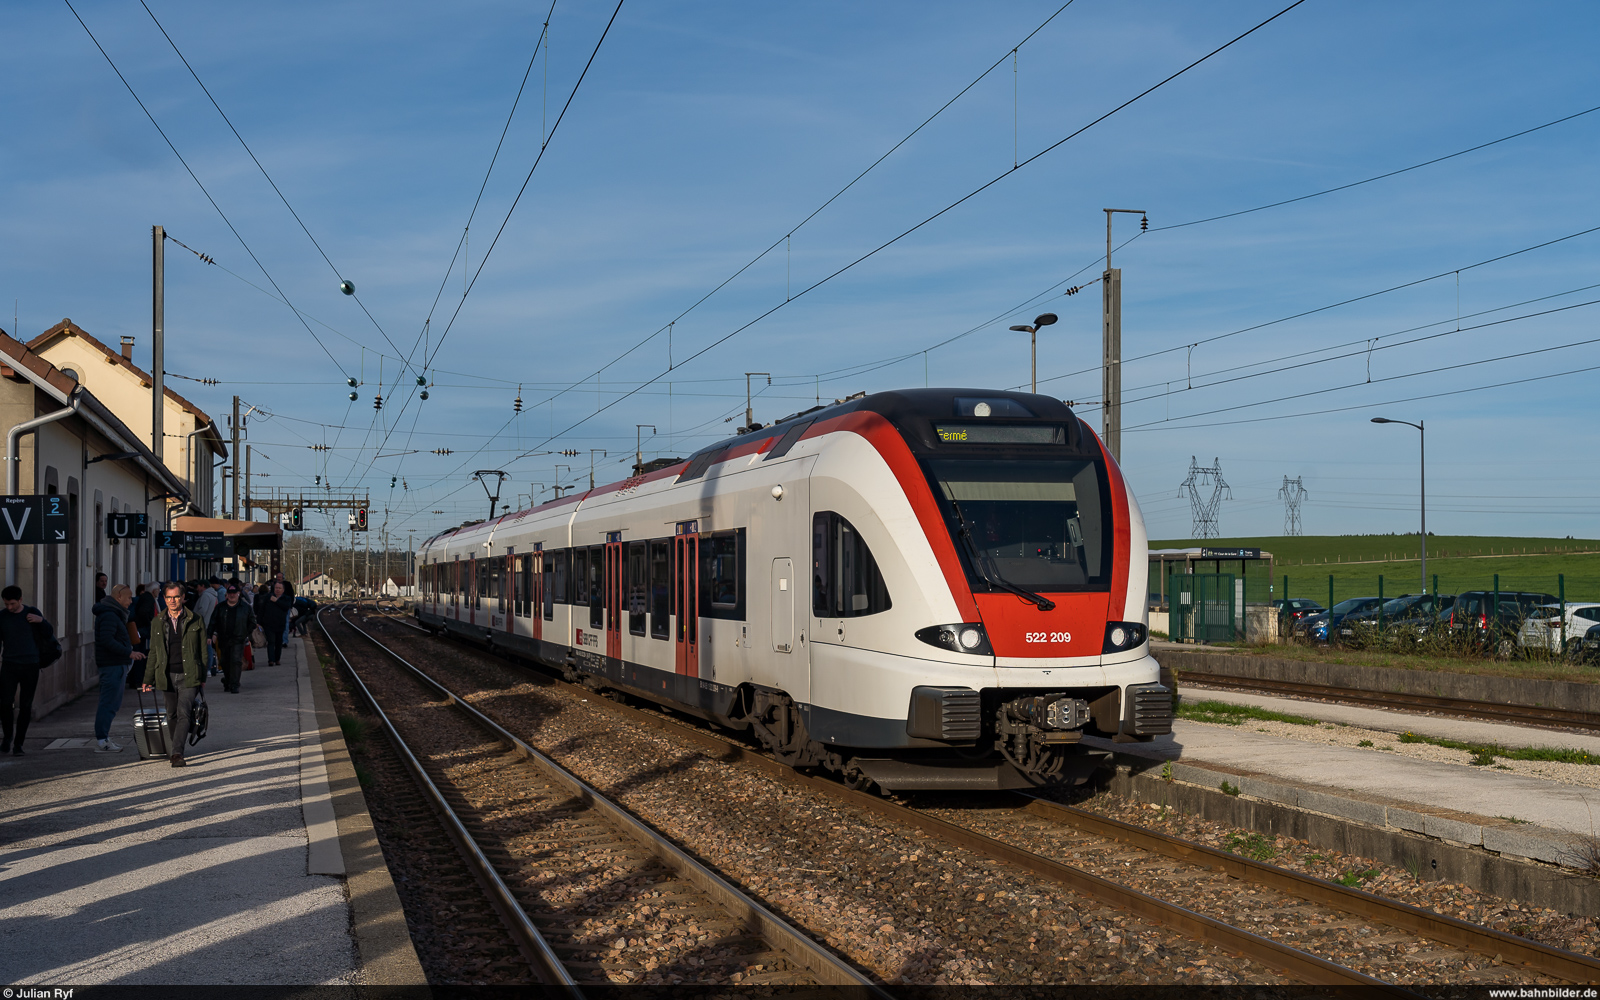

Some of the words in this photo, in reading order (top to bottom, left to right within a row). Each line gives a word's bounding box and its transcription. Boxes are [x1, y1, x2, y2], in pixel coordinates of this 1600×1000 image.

[937, 429, 968, 440] Fermé
[51, 503, 60, 514] 2
[2, 508, 32, 540] V
[114, 519, 128, 537] U
[164, 536, 171, 546] 2
[1026, 632, 1047, 643] 522
[1050, 632, 1072, 642] 209
